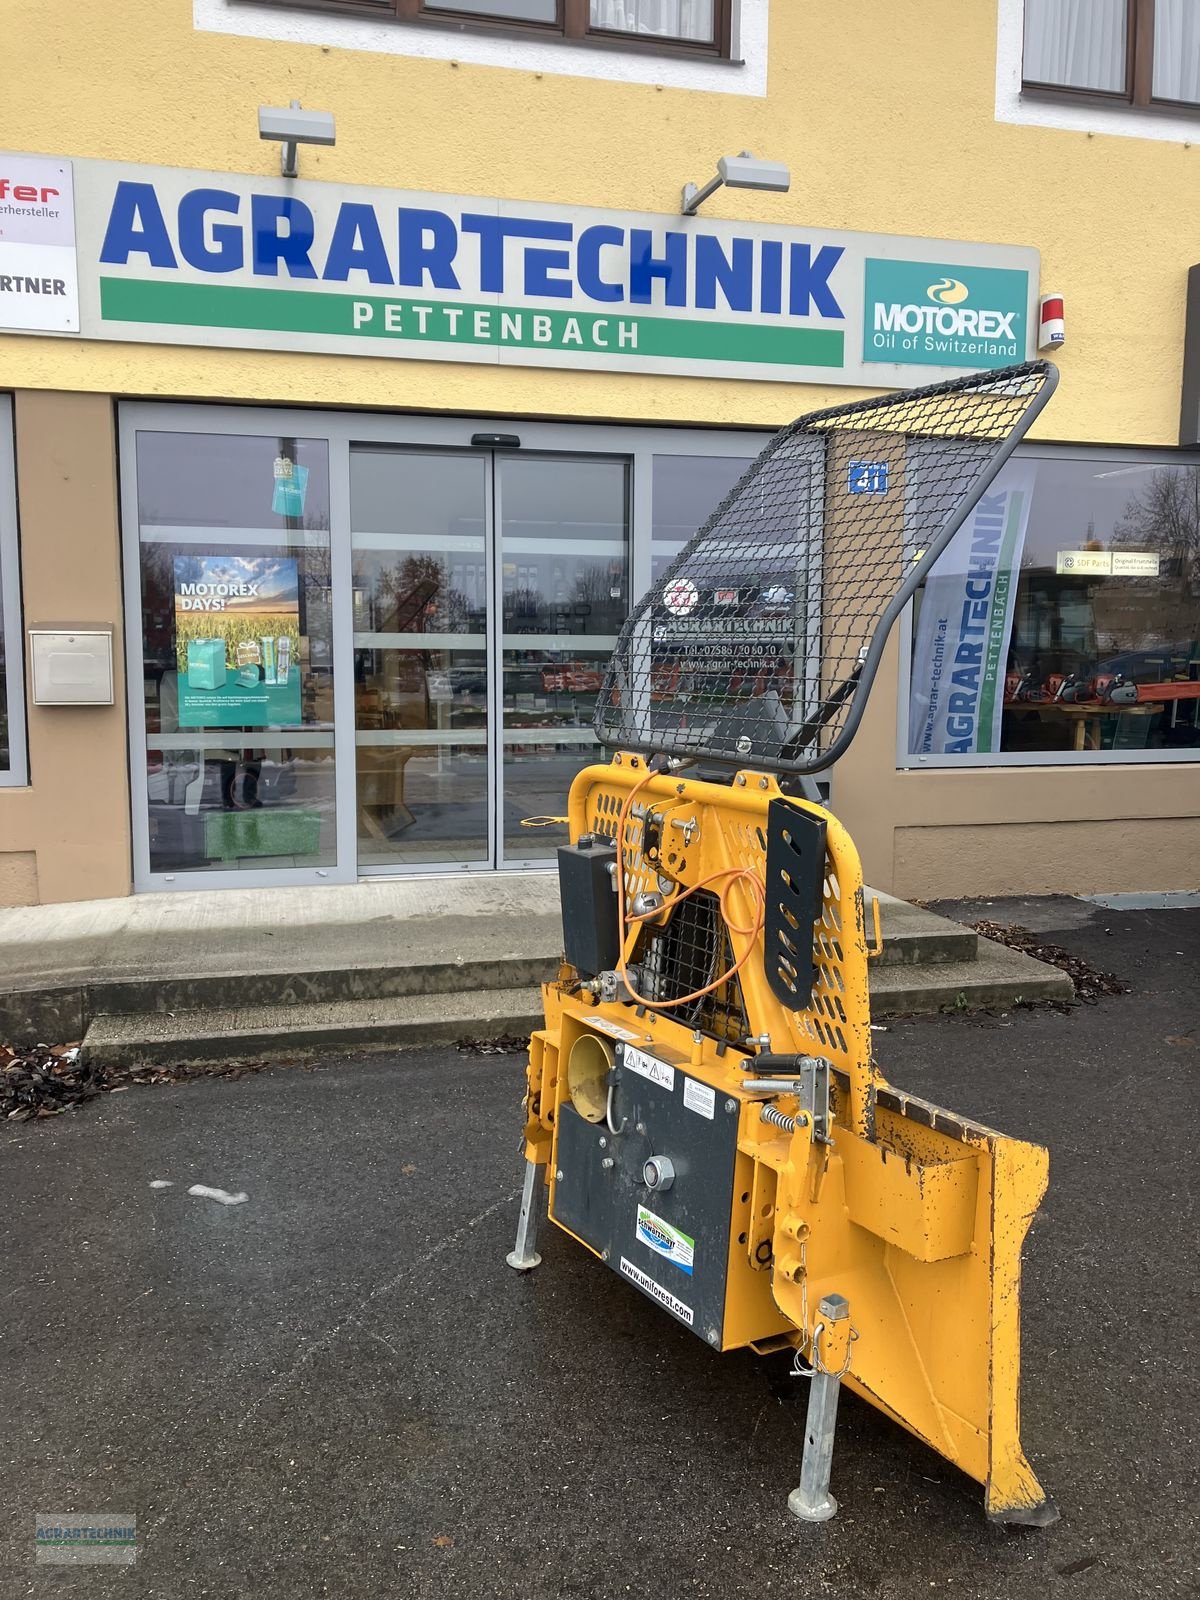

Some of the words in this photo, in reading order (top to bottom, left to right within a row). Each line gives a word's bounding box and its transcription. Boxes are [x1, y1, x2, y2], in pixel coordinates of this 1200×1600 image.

[99, 181, 846, 319] AGRARTECHNIK
[0, 275, 66, 296] RTNER
[353, 302, 638, 348] PETTENBACH
[873, 302, 1016, 340] MOTOREX
[873, 333, 895, 348] Oil
[902, 336, 918, 350] of
[924, 337, 1017, 356] Switzerland
[857, 470, 879, 490] 41
[1092, 560, 1110, 568] Parts
[180, 583, 258, 596] MOTOREX
[181, 599, 225, 611] DAYS!
[944, 491, 1008, 753] AGRARTECHNIK
[986, 575, 1009, 681] PETTENBACH
[922, 618, 949, 753] www.agrar-technik.at
[621, 1261, 692, 1321] www.uniforest.com
